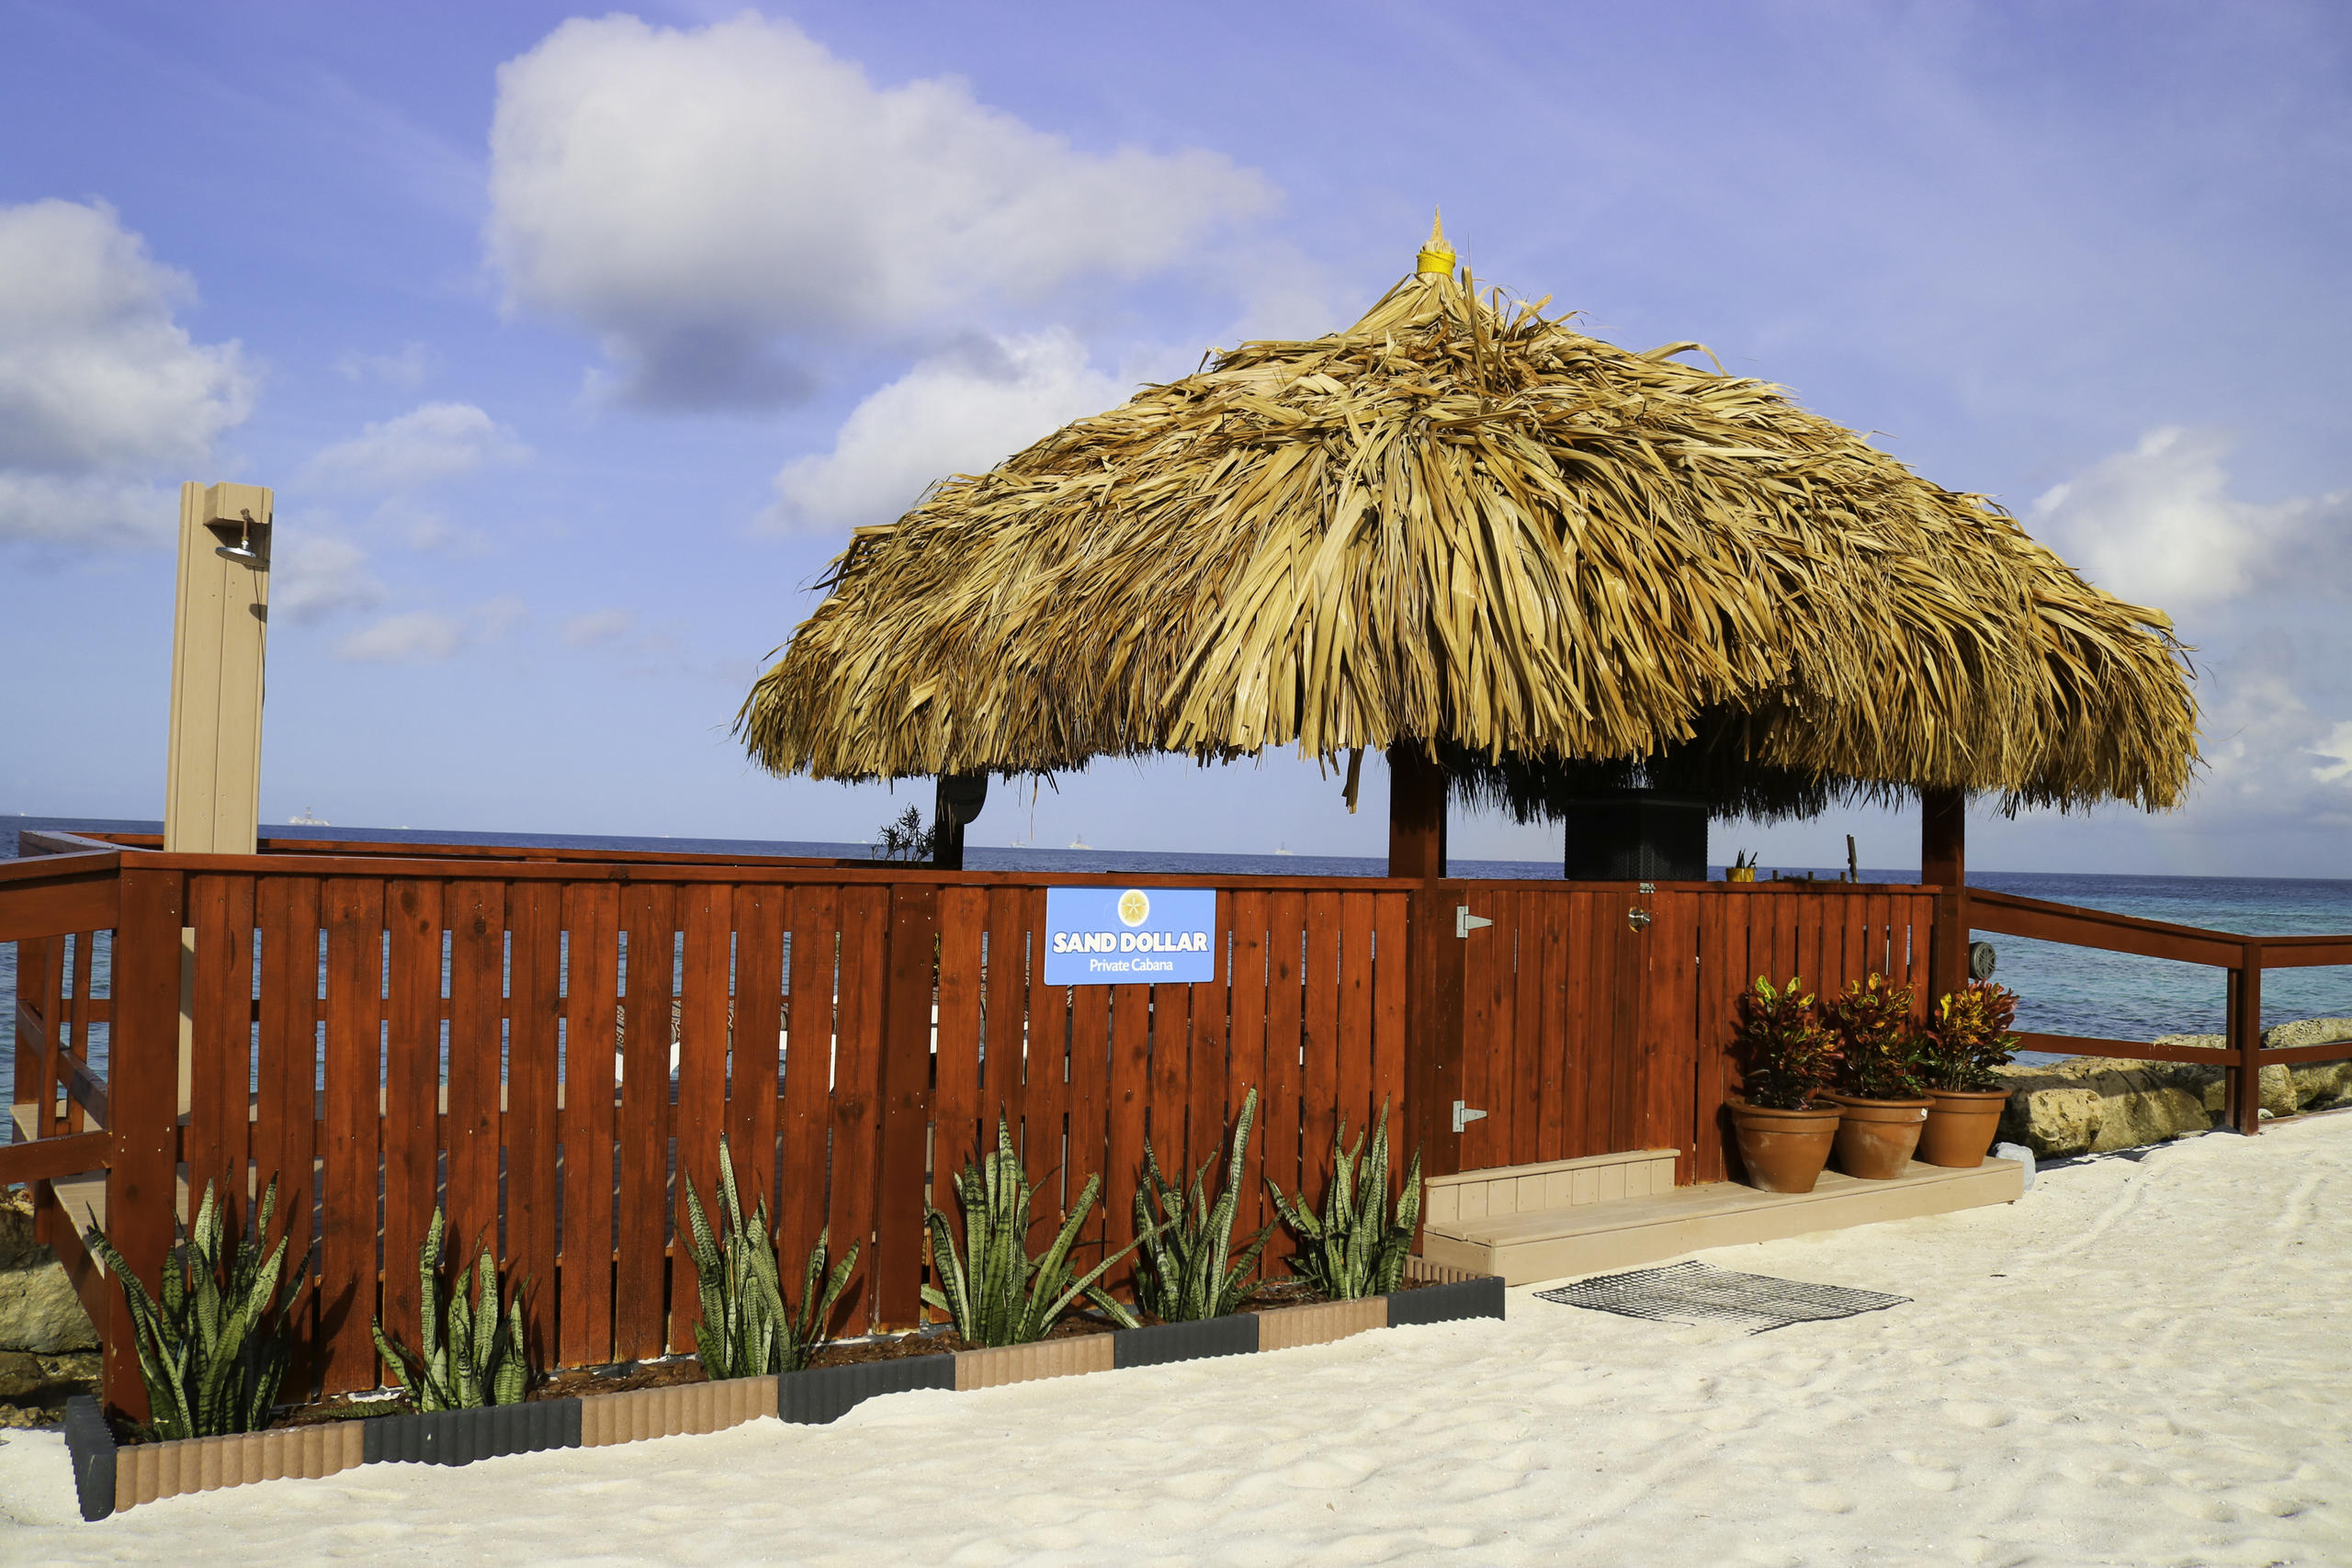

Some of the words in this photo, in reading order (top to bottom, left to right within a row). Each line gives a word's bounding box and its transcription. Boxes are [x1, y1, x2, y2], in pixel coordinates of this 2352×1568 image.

[1053, 931, 1117, 953] SAND
[1119, 931, 1209, 953] DOLLAR
[1090, 958, 1129, 972] Private
[1131, 958, 1173, 971] Cabana
